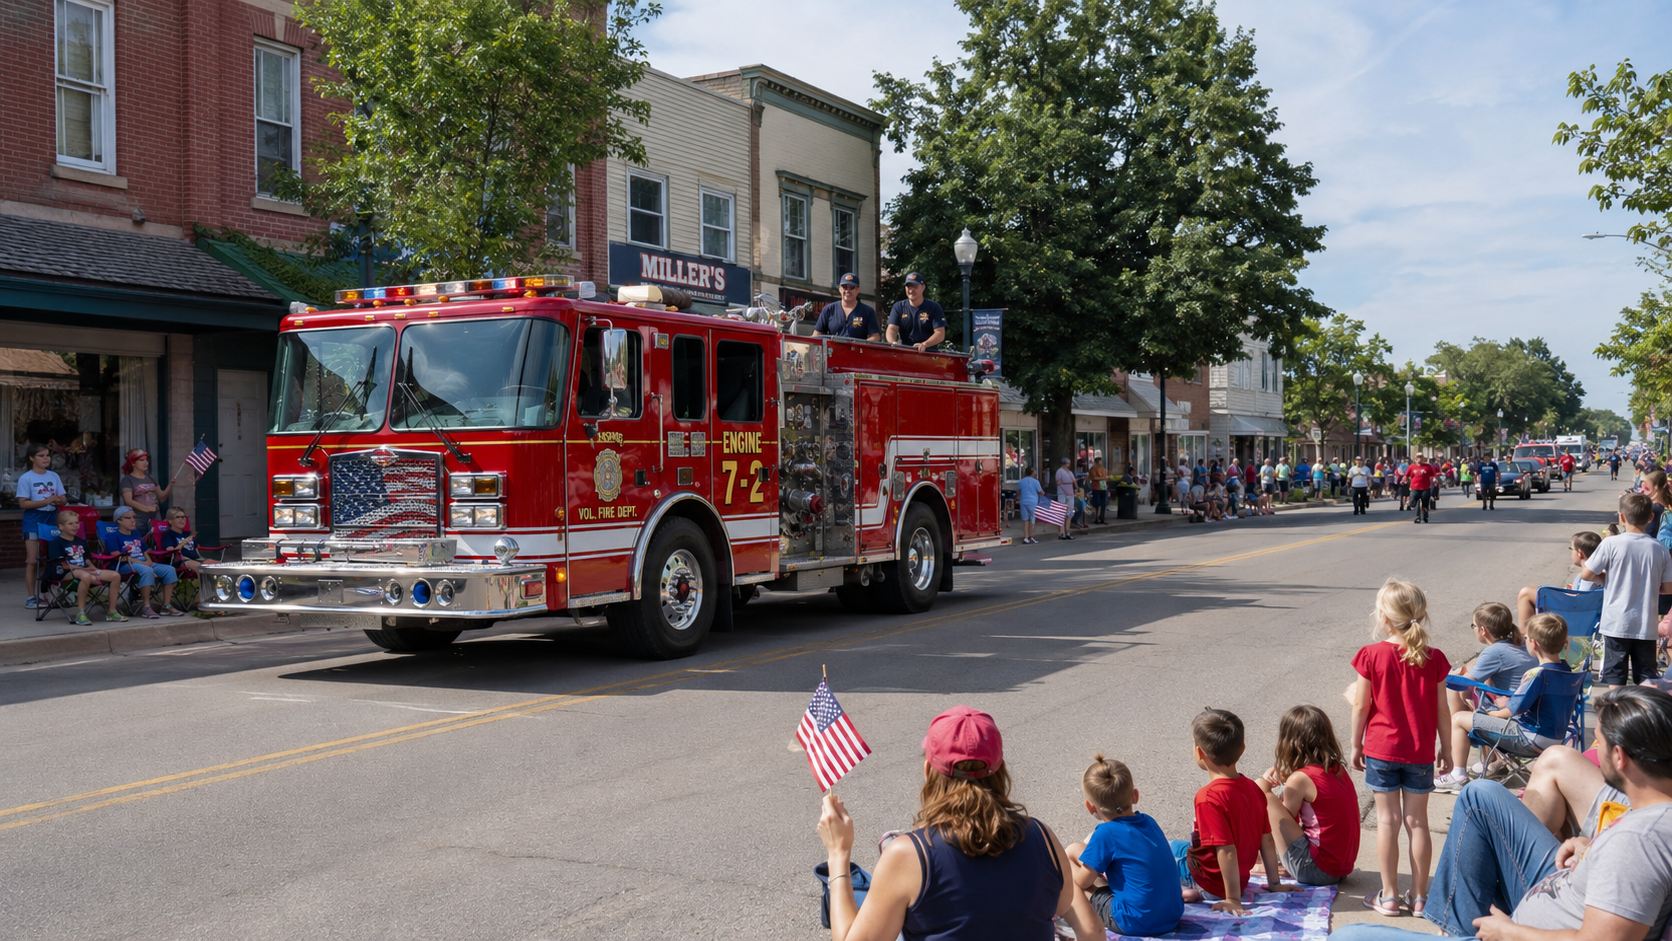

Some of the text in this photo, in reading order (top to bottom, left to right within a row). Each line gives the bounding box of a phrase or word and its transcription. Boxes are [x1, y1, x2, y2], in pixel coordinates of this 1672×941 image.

[640, 252, 726, 292] MILLER'S
[722, 431, 763, 454] ENGINE
[722, 459, 765, 505] 7-2
[578, 505, 638, 520] VOL. FIRE DEPT.
